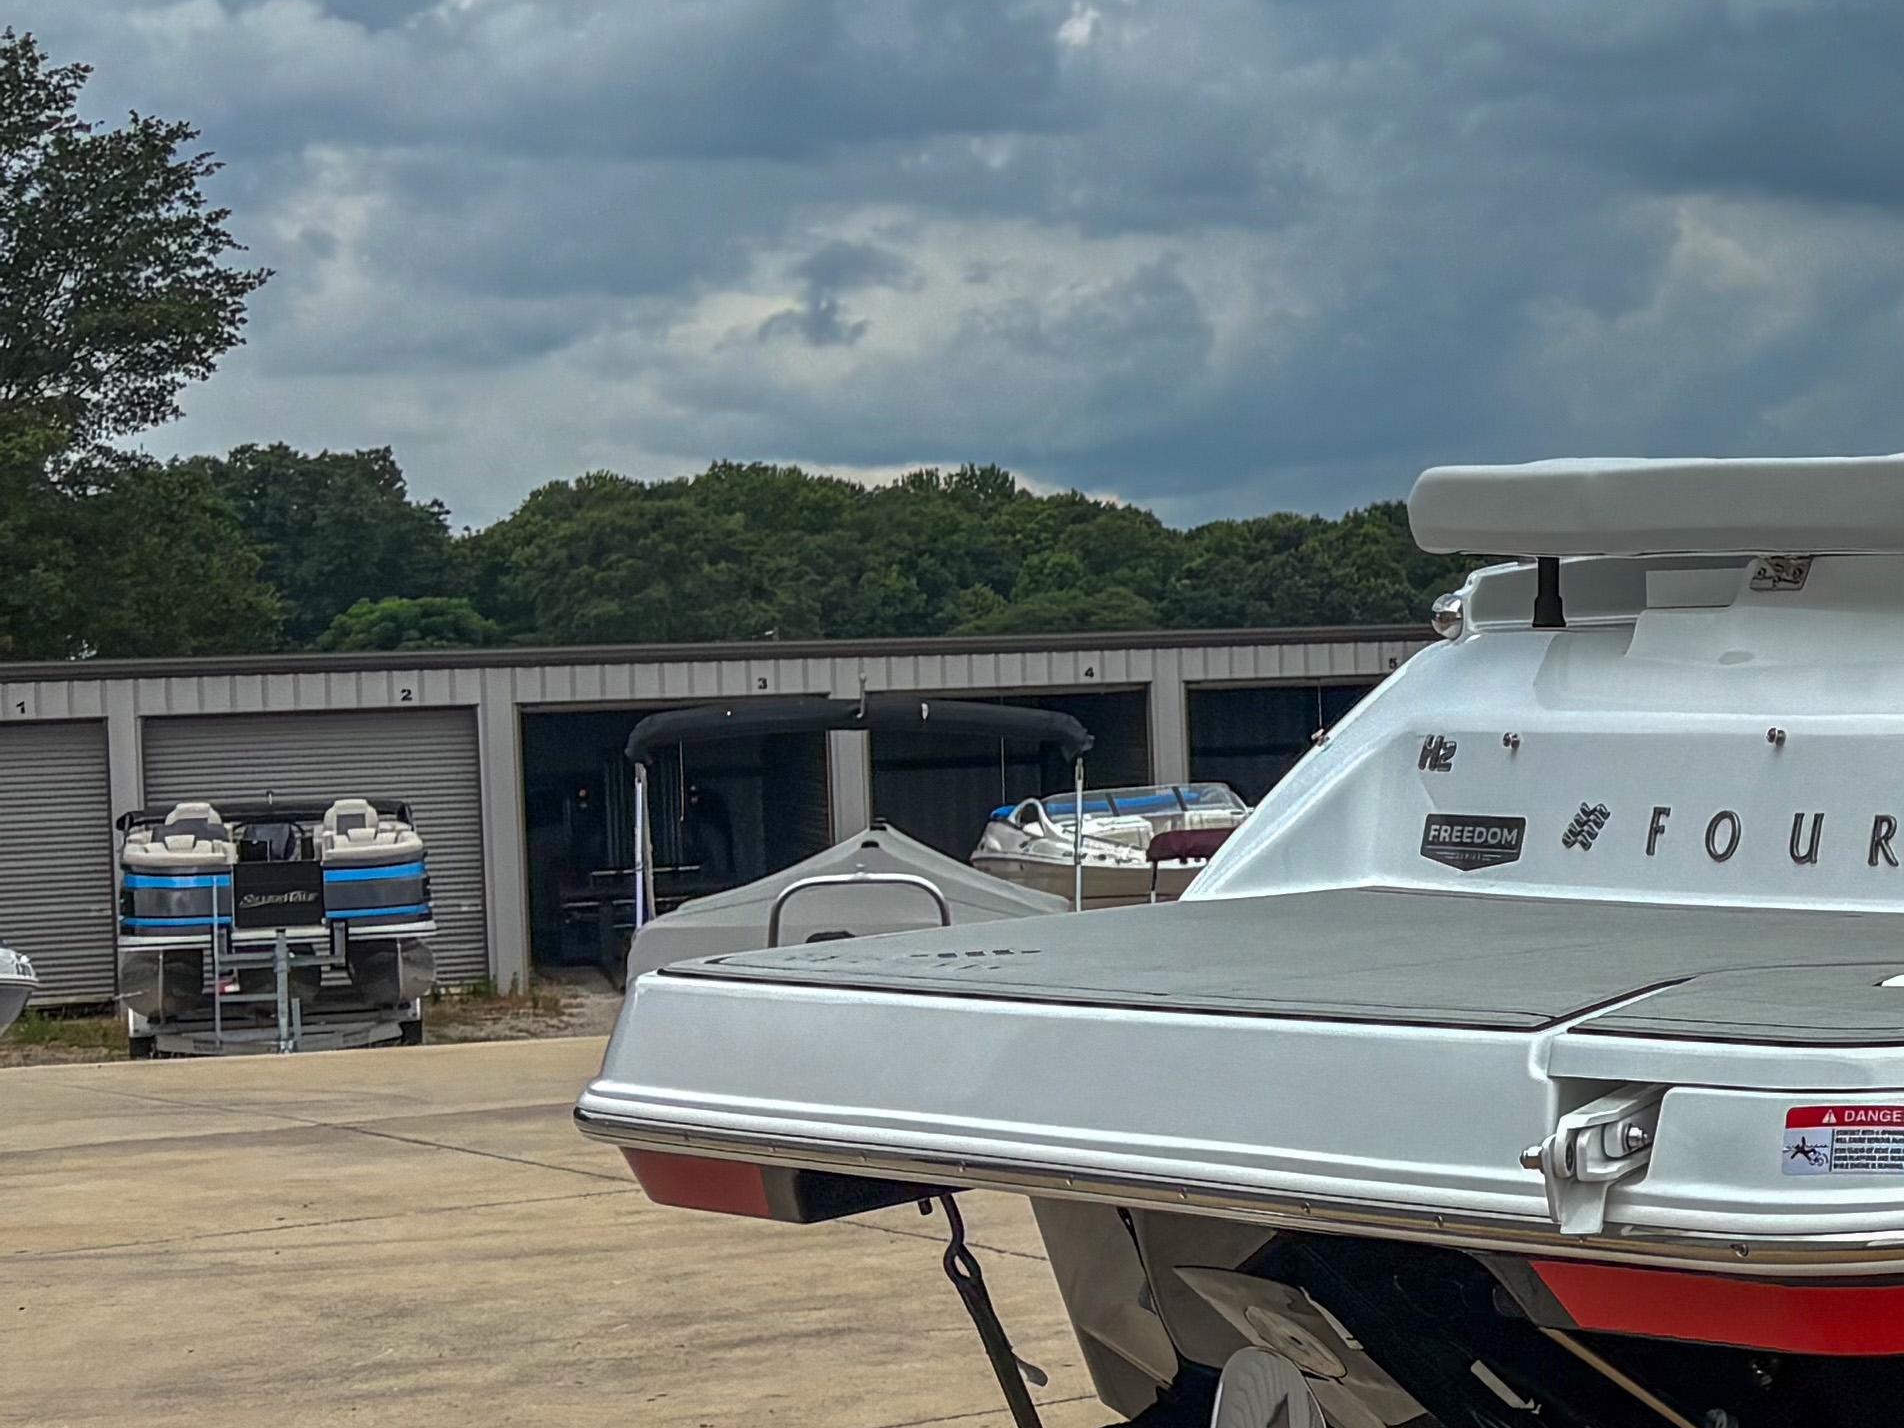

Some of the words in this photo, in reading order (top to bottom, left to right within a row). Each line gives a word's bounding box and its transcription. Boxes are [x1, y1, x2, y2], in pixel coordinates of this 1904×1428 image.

[1084, 666, 1095, 678] 4
[757, 677, 768, 689] 3
[401, 689, 412, 701] 2
[16, 701, 26, 714] 1
[1418, 734, 1457, 772] H2
[1428, 824, 1518, 846] FREEDOM
[1645, 806, 1900, 869] FOUR
